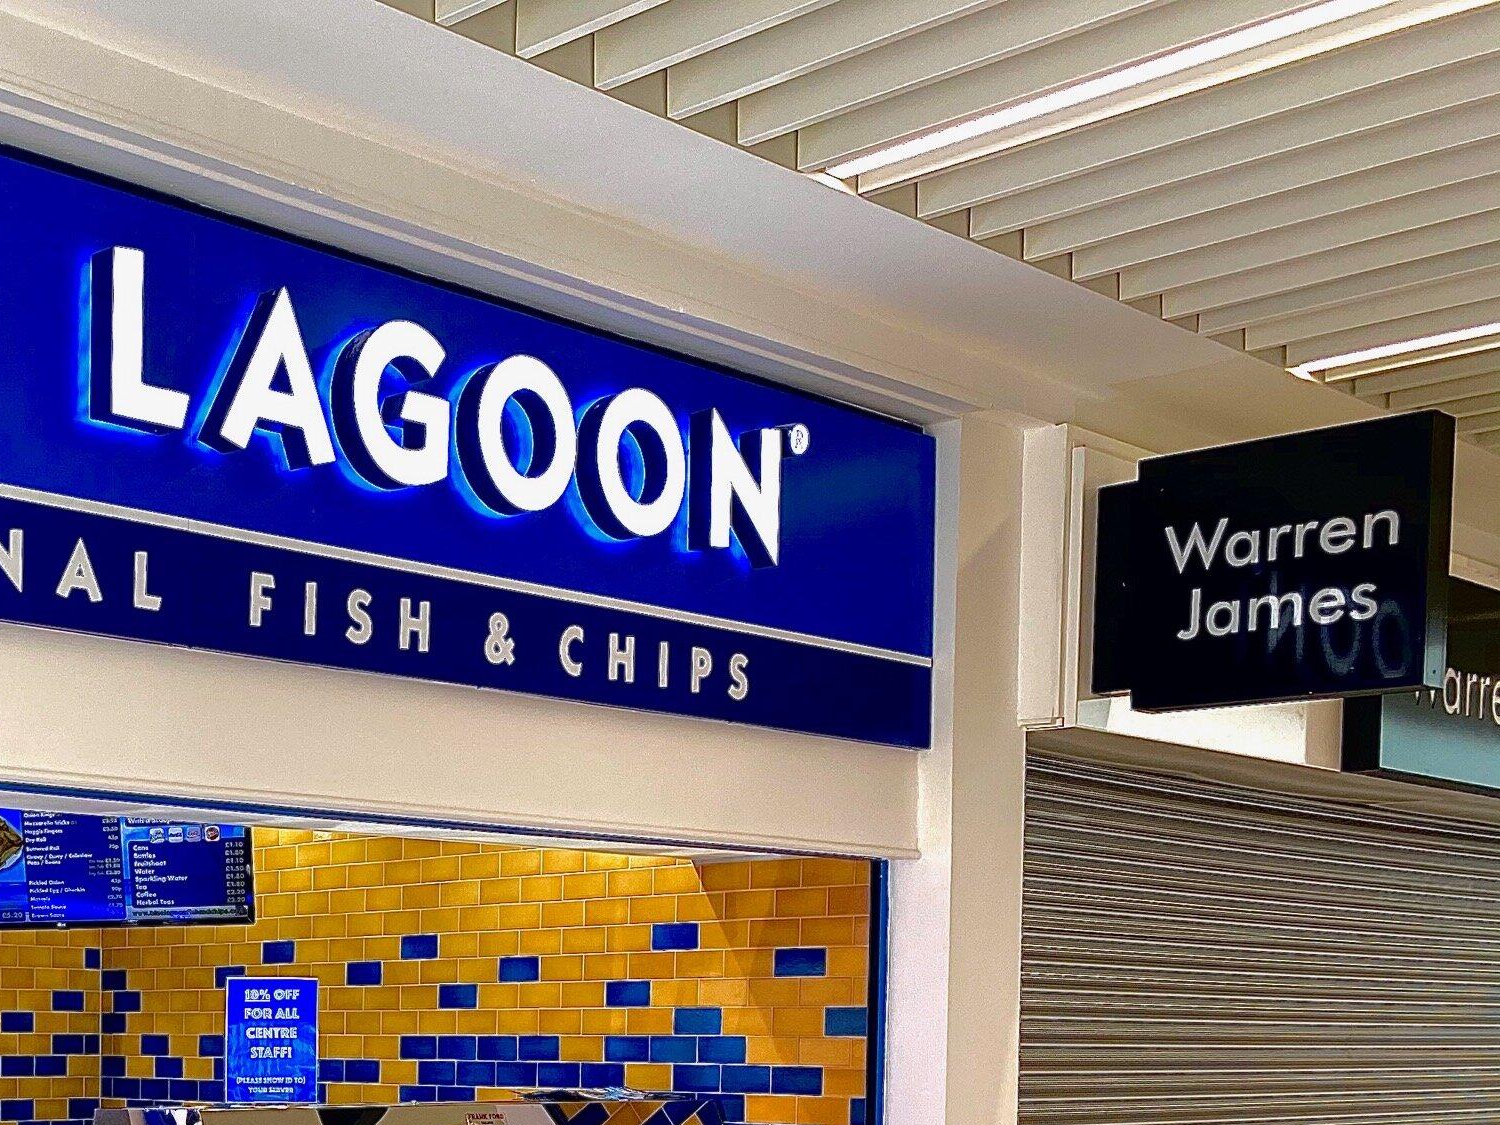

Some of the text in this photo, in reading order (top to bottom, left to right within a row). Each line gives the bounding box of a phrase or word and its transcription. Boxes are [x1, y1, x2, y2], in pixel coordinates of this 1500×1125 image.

[1164, 509, 1400, 575] Warren
[1177, 582, 1379, 640] James
[249, 572, 431, 652] FISH
[484, 612, 515, 666] &
[559, 626, 749, 701] CHIPS
[244, 988, 300, 1002] 10% OFF
[244, 1007, 300, 1019] FOR ALL
[245, 1027, 298, 1039] CENTRE
[250, 1046, 292, 1059] STAFF!
